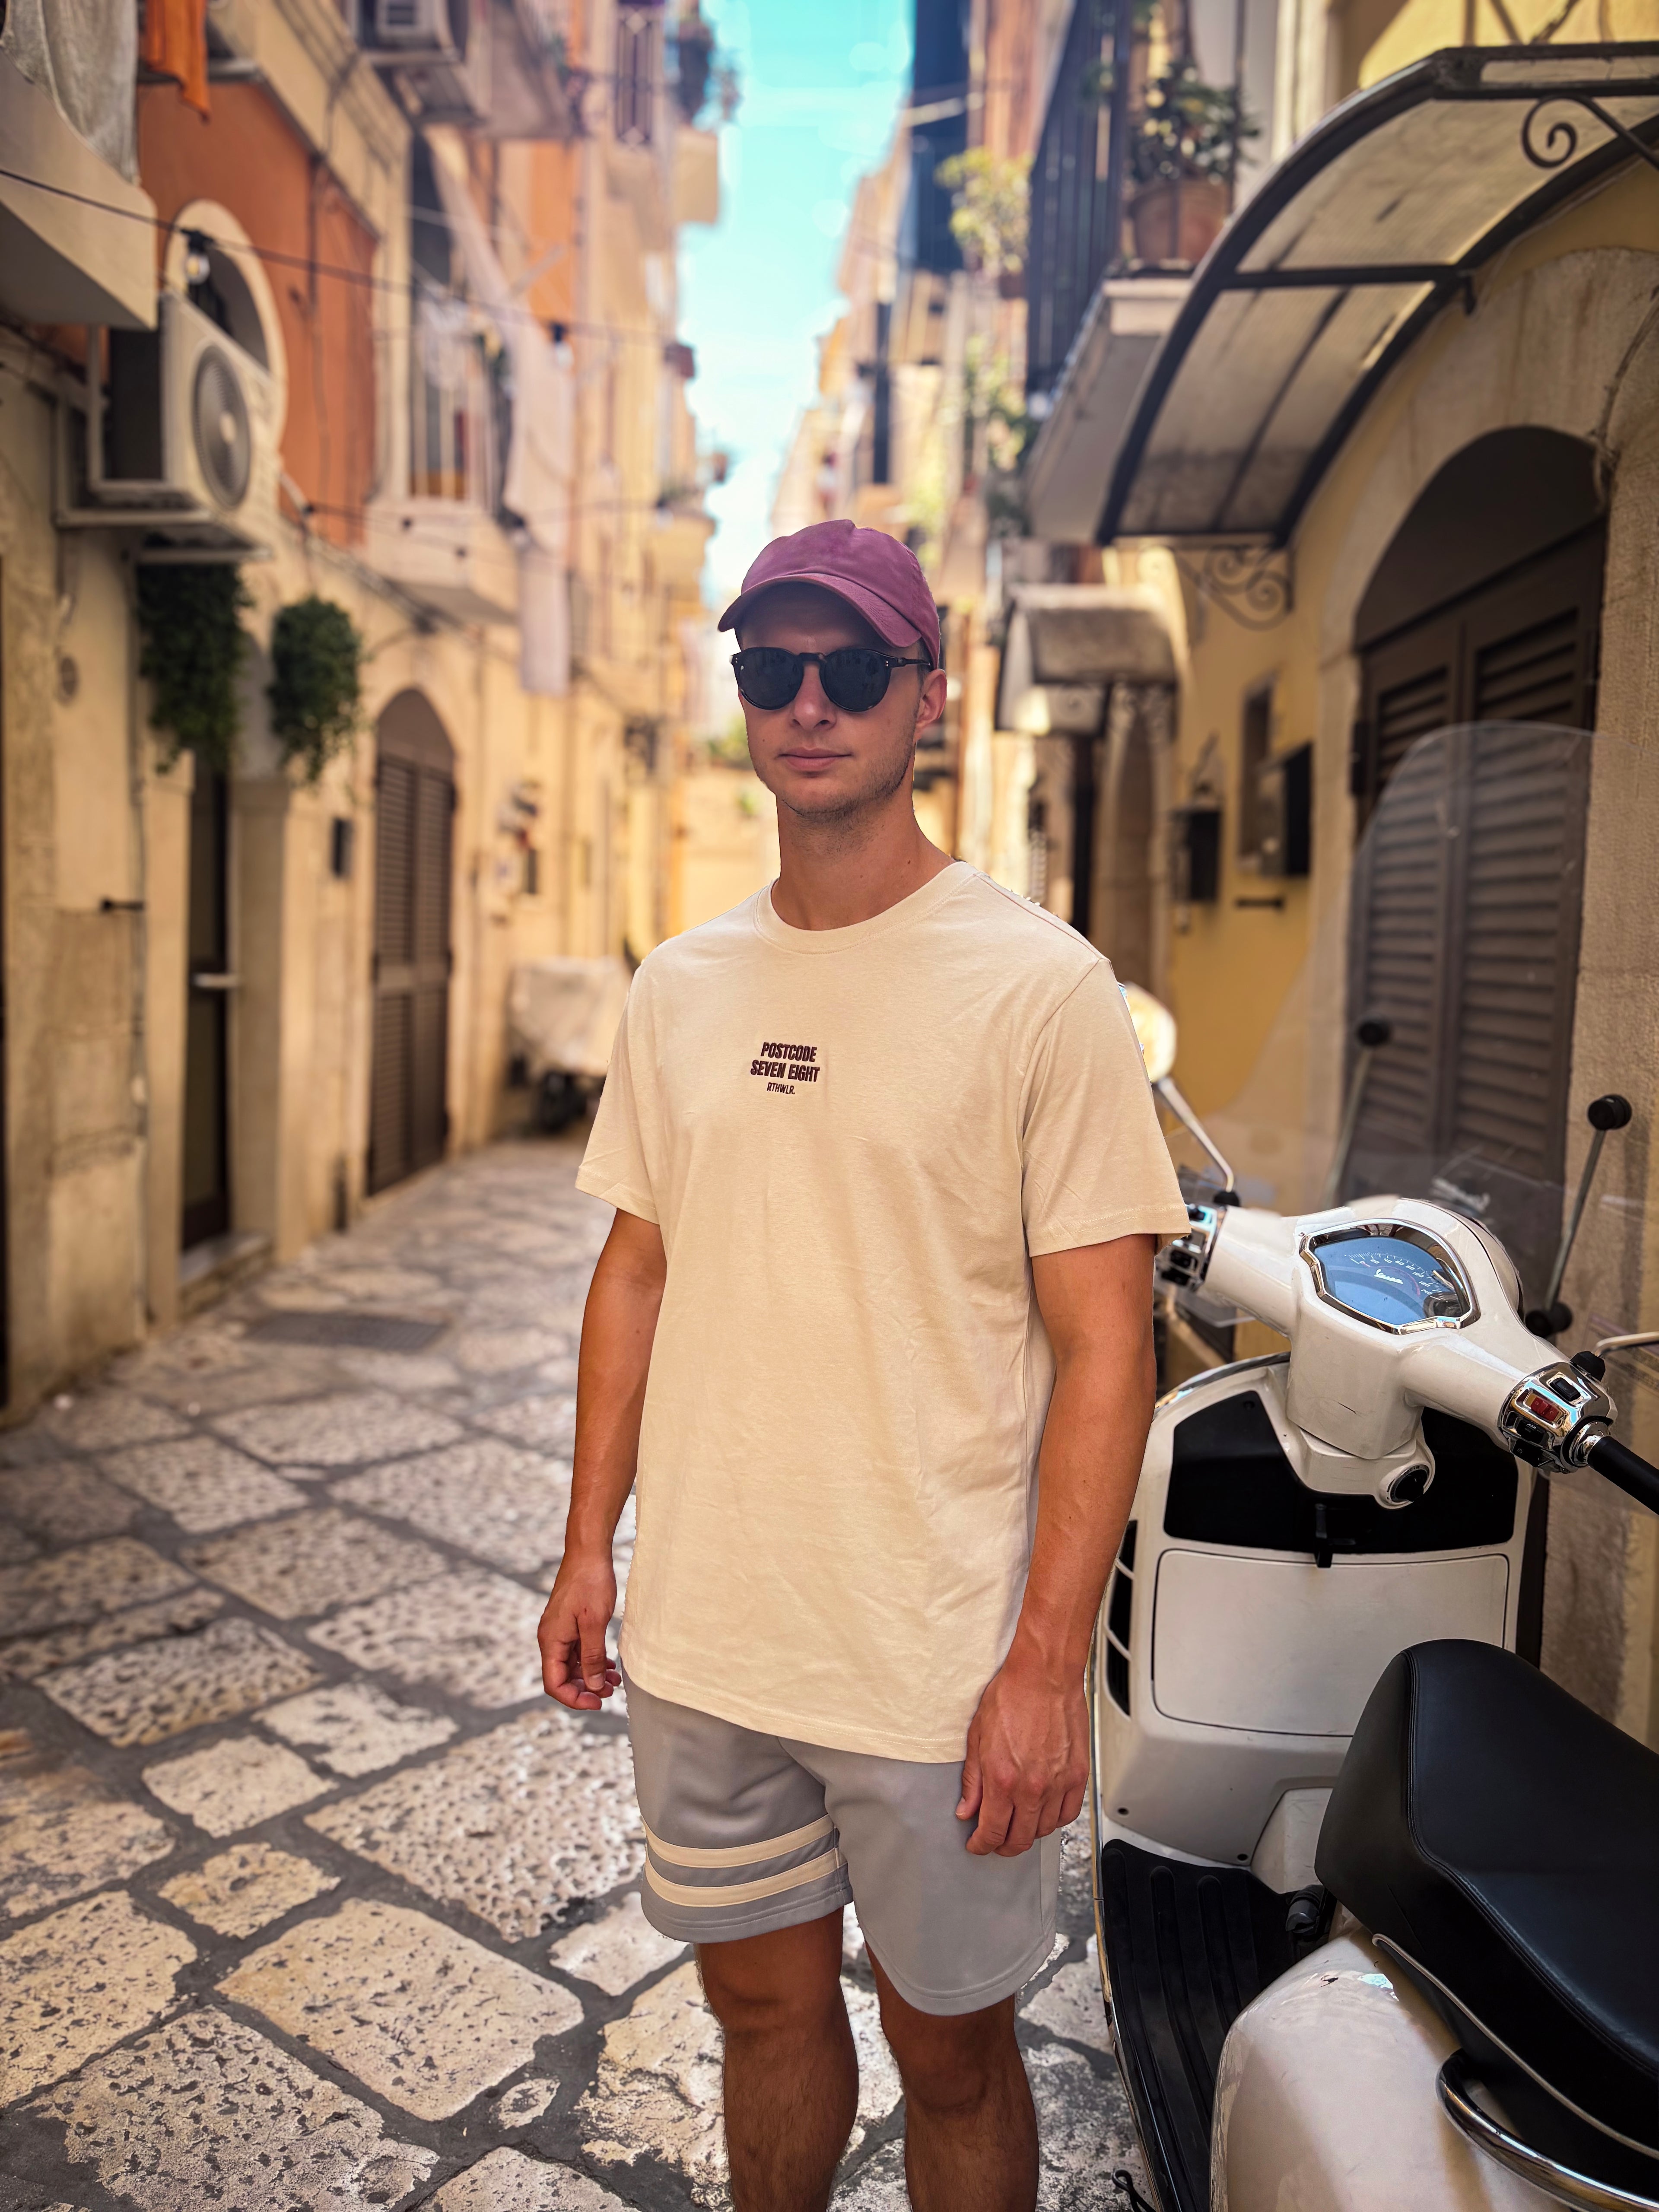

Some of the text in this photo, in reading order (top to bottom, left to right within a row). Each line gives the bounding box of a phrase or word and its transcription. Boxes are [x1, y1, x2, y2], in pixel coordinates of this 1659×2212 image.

[760, 1042, 817, 1062] POSTCODE
[750, 1060, 820, 1082] SEVEN EIGHT
